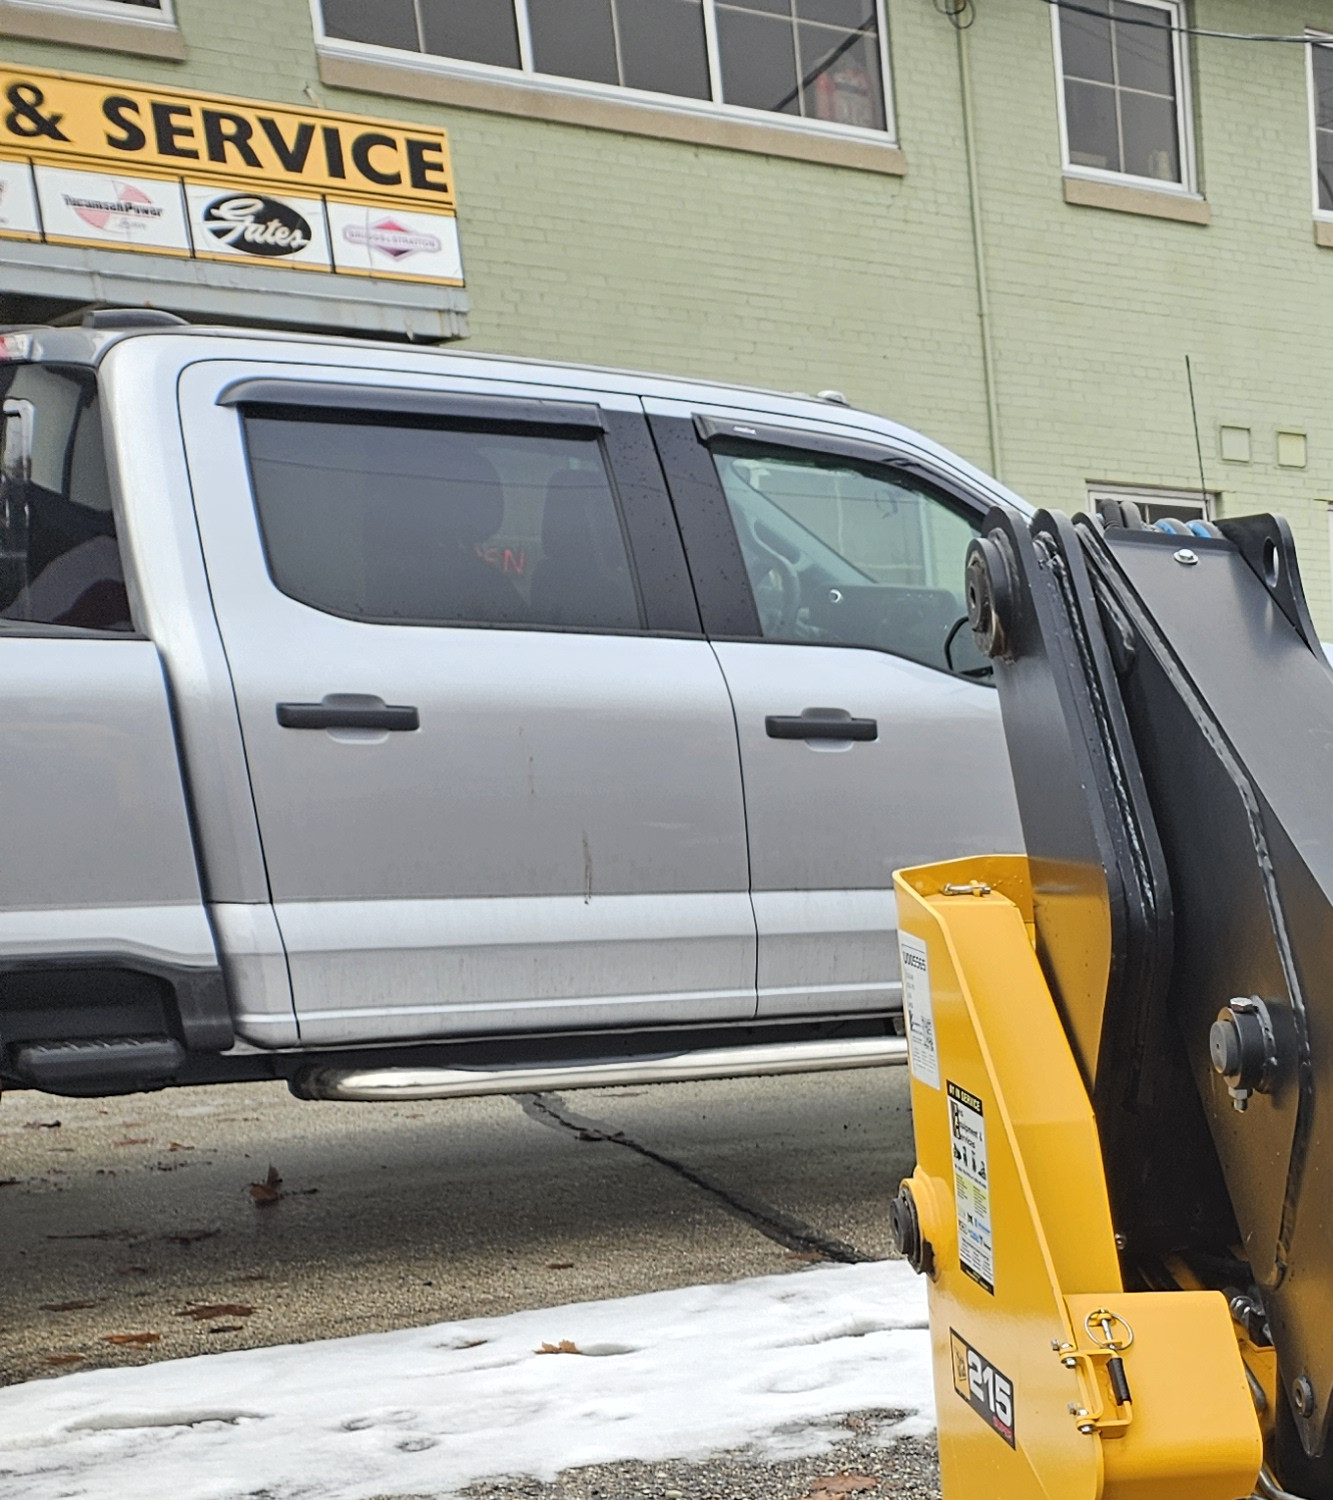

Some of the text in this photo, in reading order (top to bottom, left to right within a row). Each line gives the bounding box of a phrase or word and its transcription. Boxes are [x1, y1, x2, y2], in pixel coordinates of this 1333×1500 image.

[5, 83, 449, 194] & SERVICE
[204, 197, 311, 248] Gates
[967, 1349, 1013, 1428] 215
